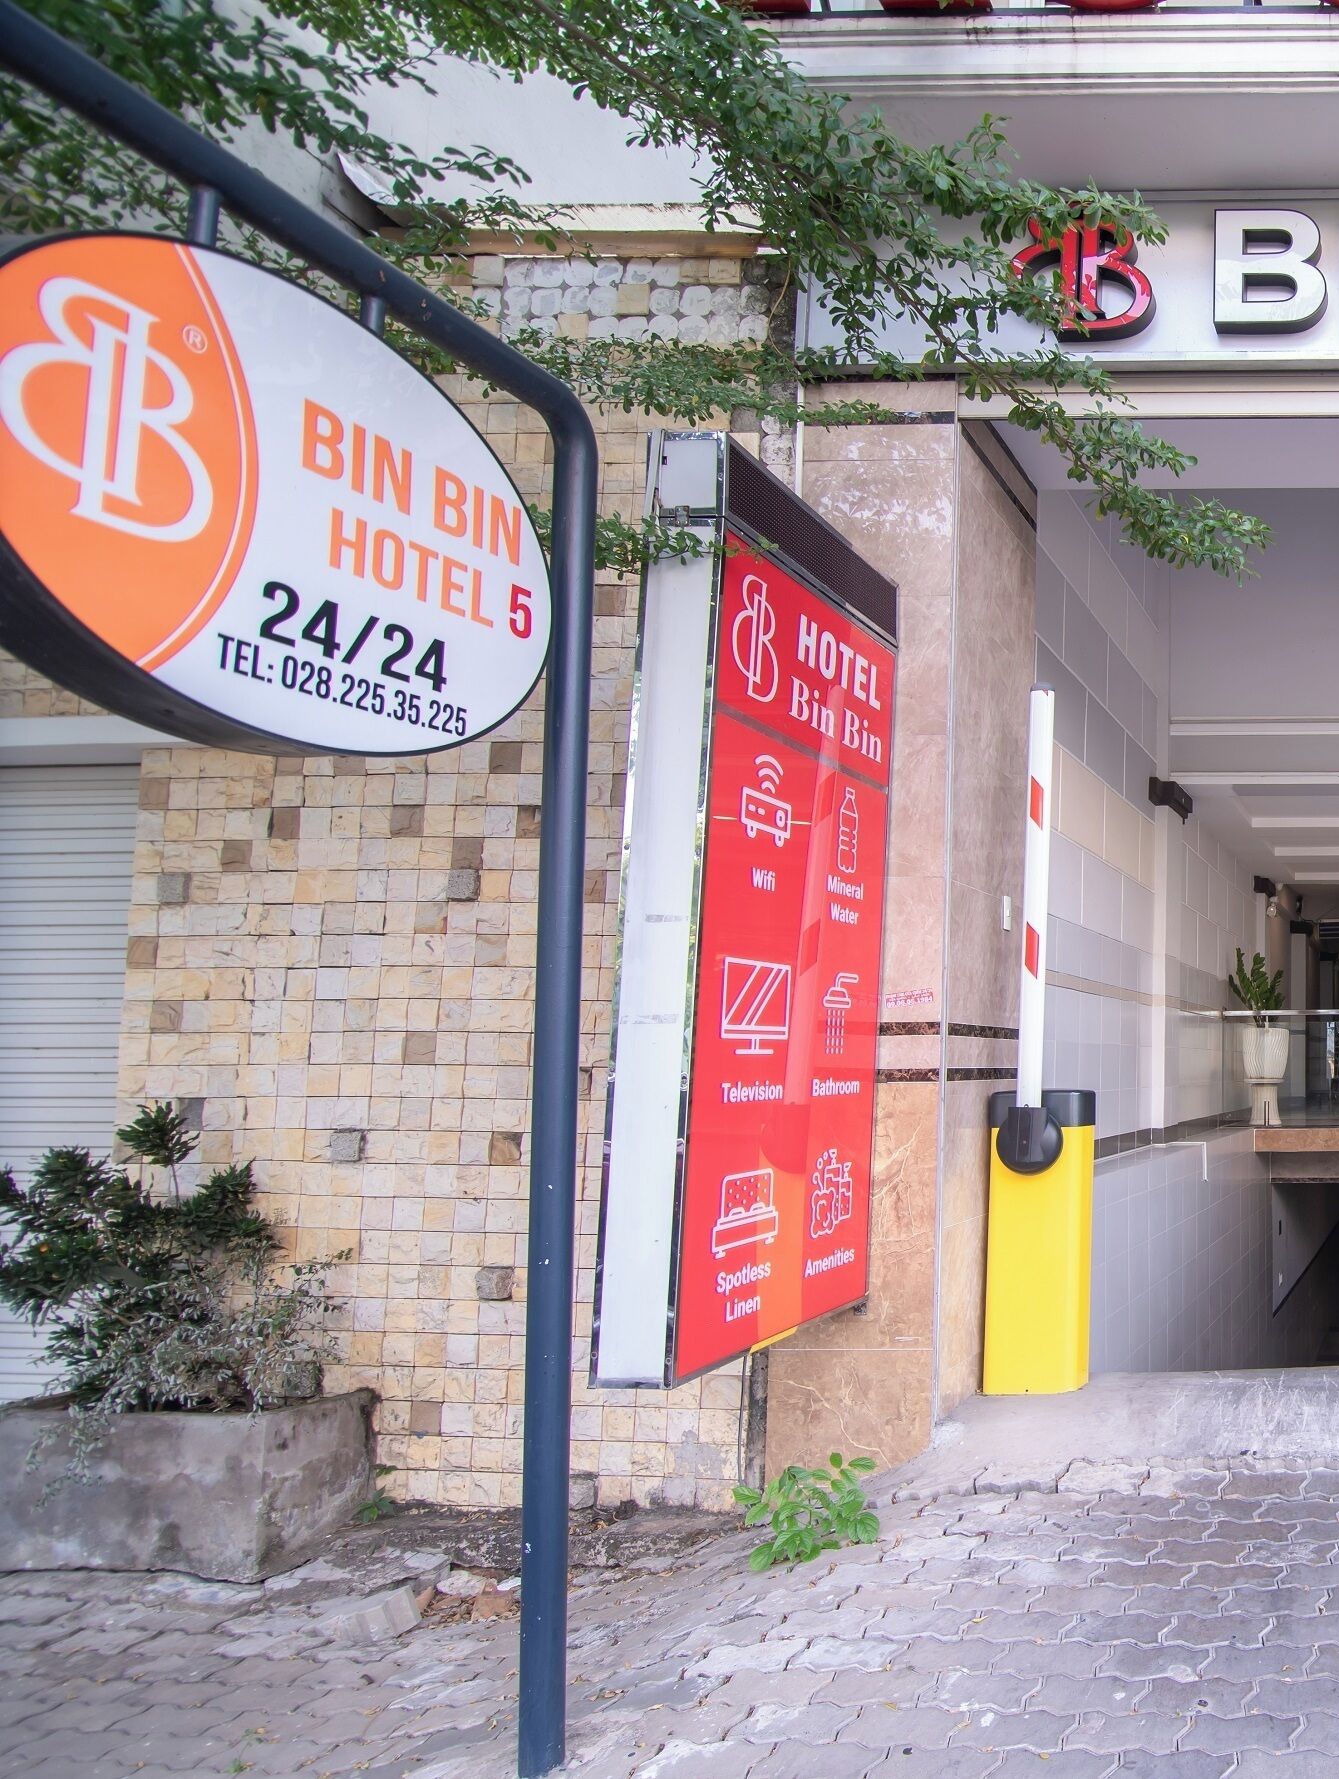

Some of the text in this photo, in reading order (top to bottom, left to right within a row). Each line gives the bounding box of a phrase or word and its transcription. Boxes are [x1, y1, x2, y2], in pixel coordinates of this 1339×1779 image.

[301, 398, 522, 566] BIN BIN
[328, 507, 532, 639] HOTEL 5
[260, 580, 447, 692] 24/24
[797, 613, 880, 711] HOTEL
[217, 633, 467, 737] TEL: 028.225.35.225
[788, 675, 882, 764] Bin Bin
[752, 867, 776, 892] Wifi
[827, 874, 864, 901] Mineral
[830, 902, 859, 925] Water
[721, 1080, 783, 1103] Television
[812, 1077, 860, 1097] Bathroom
[716, 1262, 771, 1296] Spotless
[804, 1248, 855, 1278] Amenities
[725, 1295, 761, 1322] Linen
